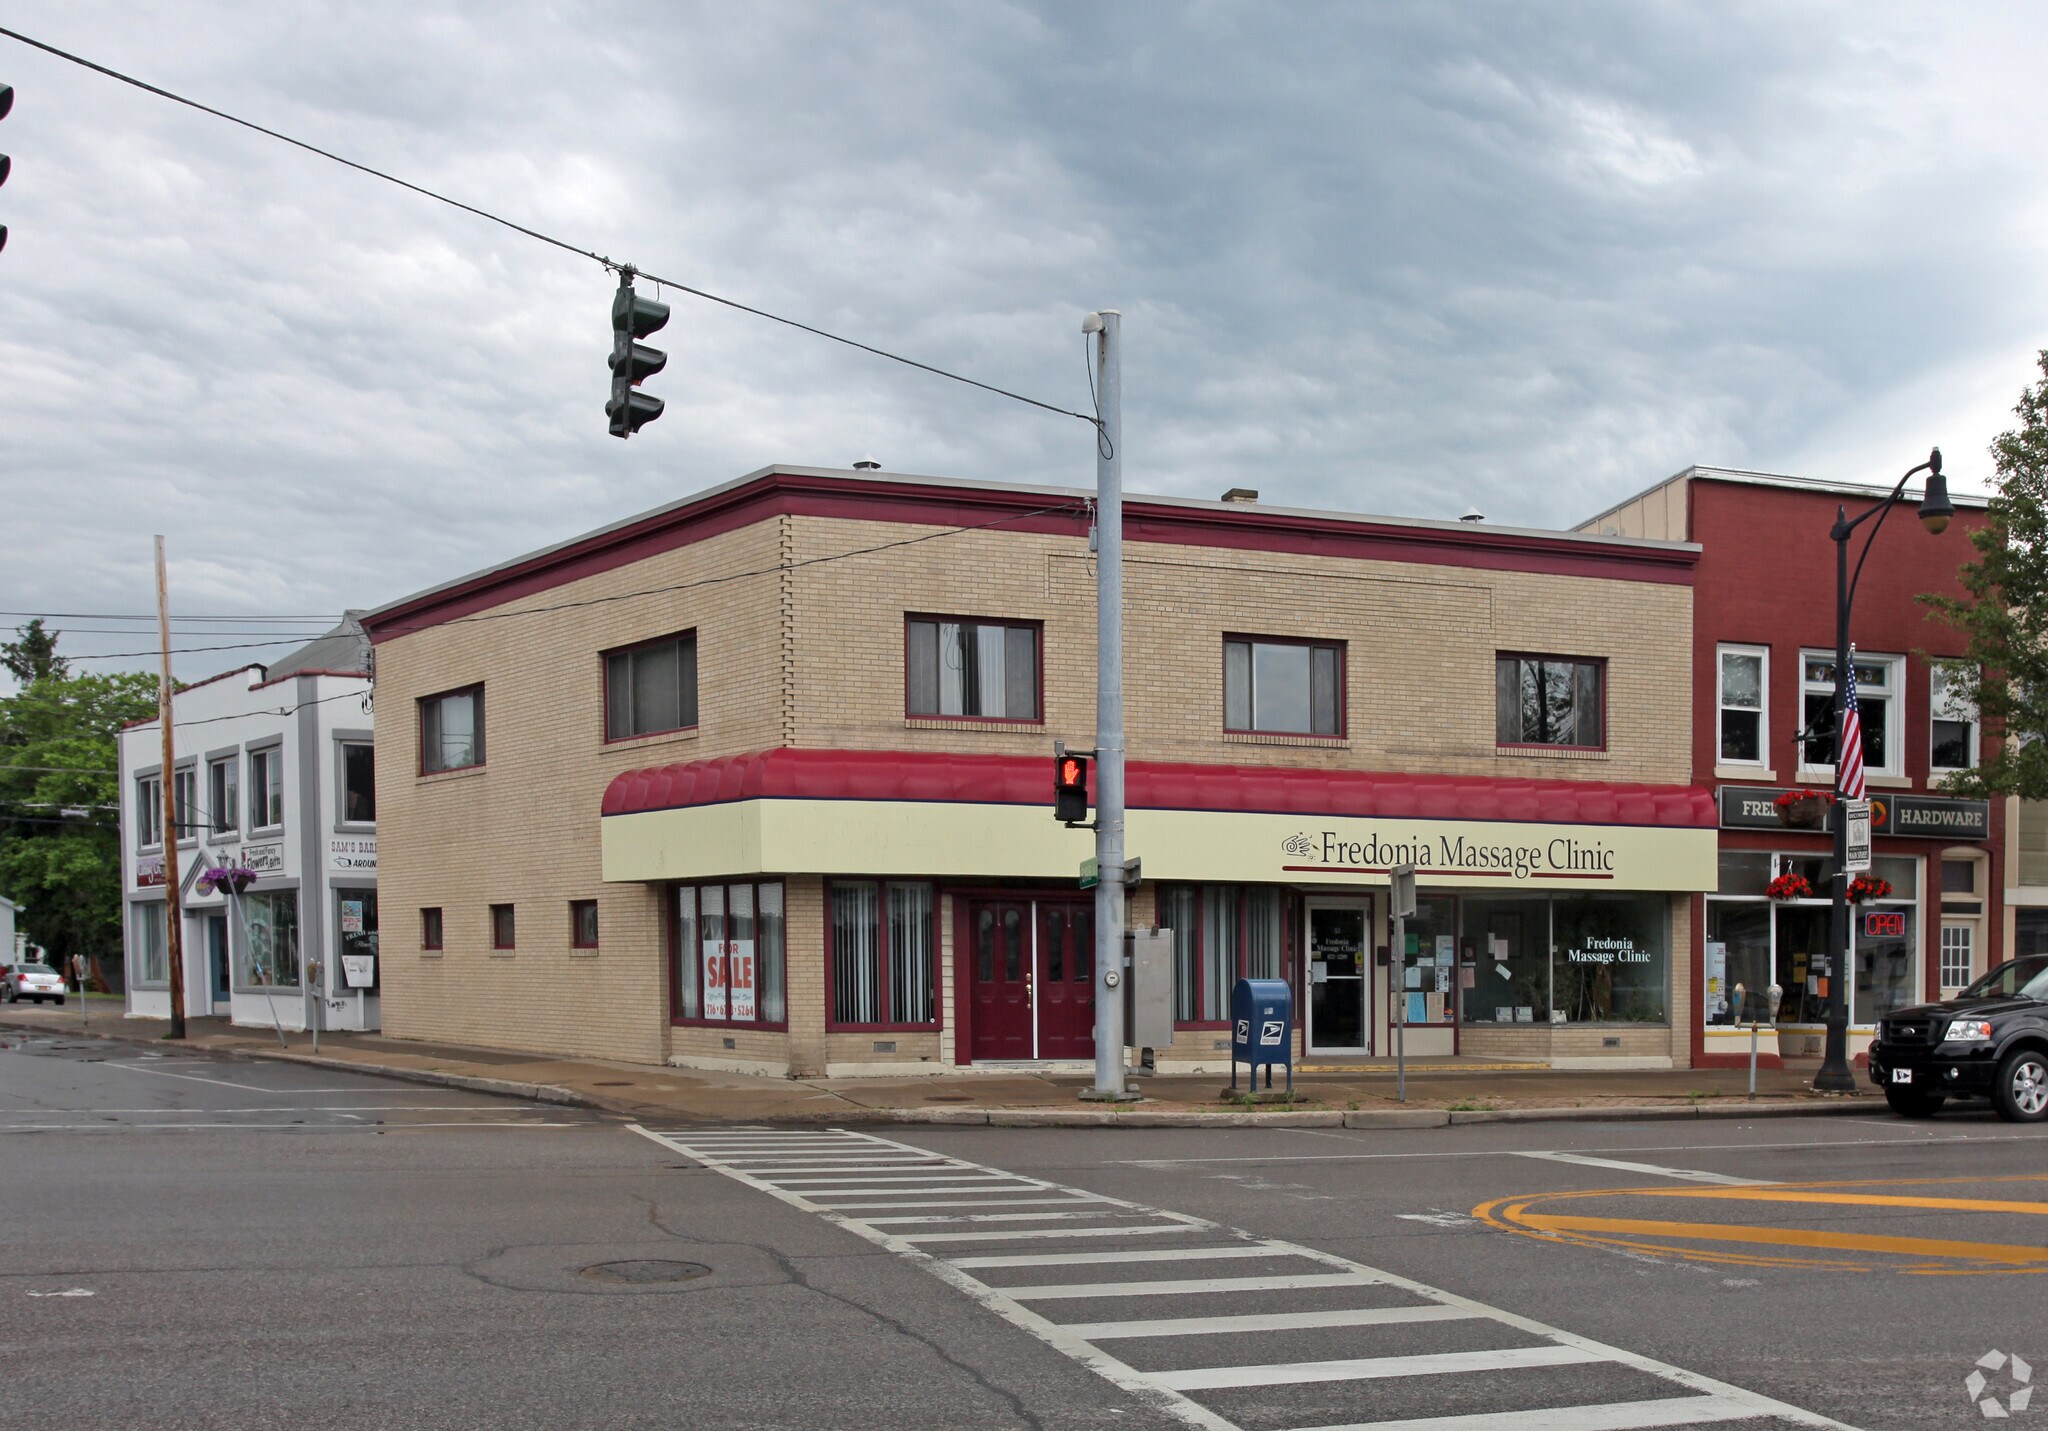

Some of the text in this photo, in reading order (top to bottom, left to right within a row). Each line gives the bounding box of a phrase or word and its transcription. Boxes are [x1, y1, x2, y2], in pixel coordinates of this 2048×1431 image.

[1900, 808, 1983, 827] HARDWARE
[331, 841, 355, 853] SAM'S
[1320, 831, 1615, 880] Fredonia Massage Clinic
[1867, 914, 1904, 936] OPEN
[345, 930, 366, 941] FRESH
[1586, 936, 1633, 950] Fredonia
[1567, 949, 1652, 965] Massage Clinic
[708, 956, 752, 988] SALE
